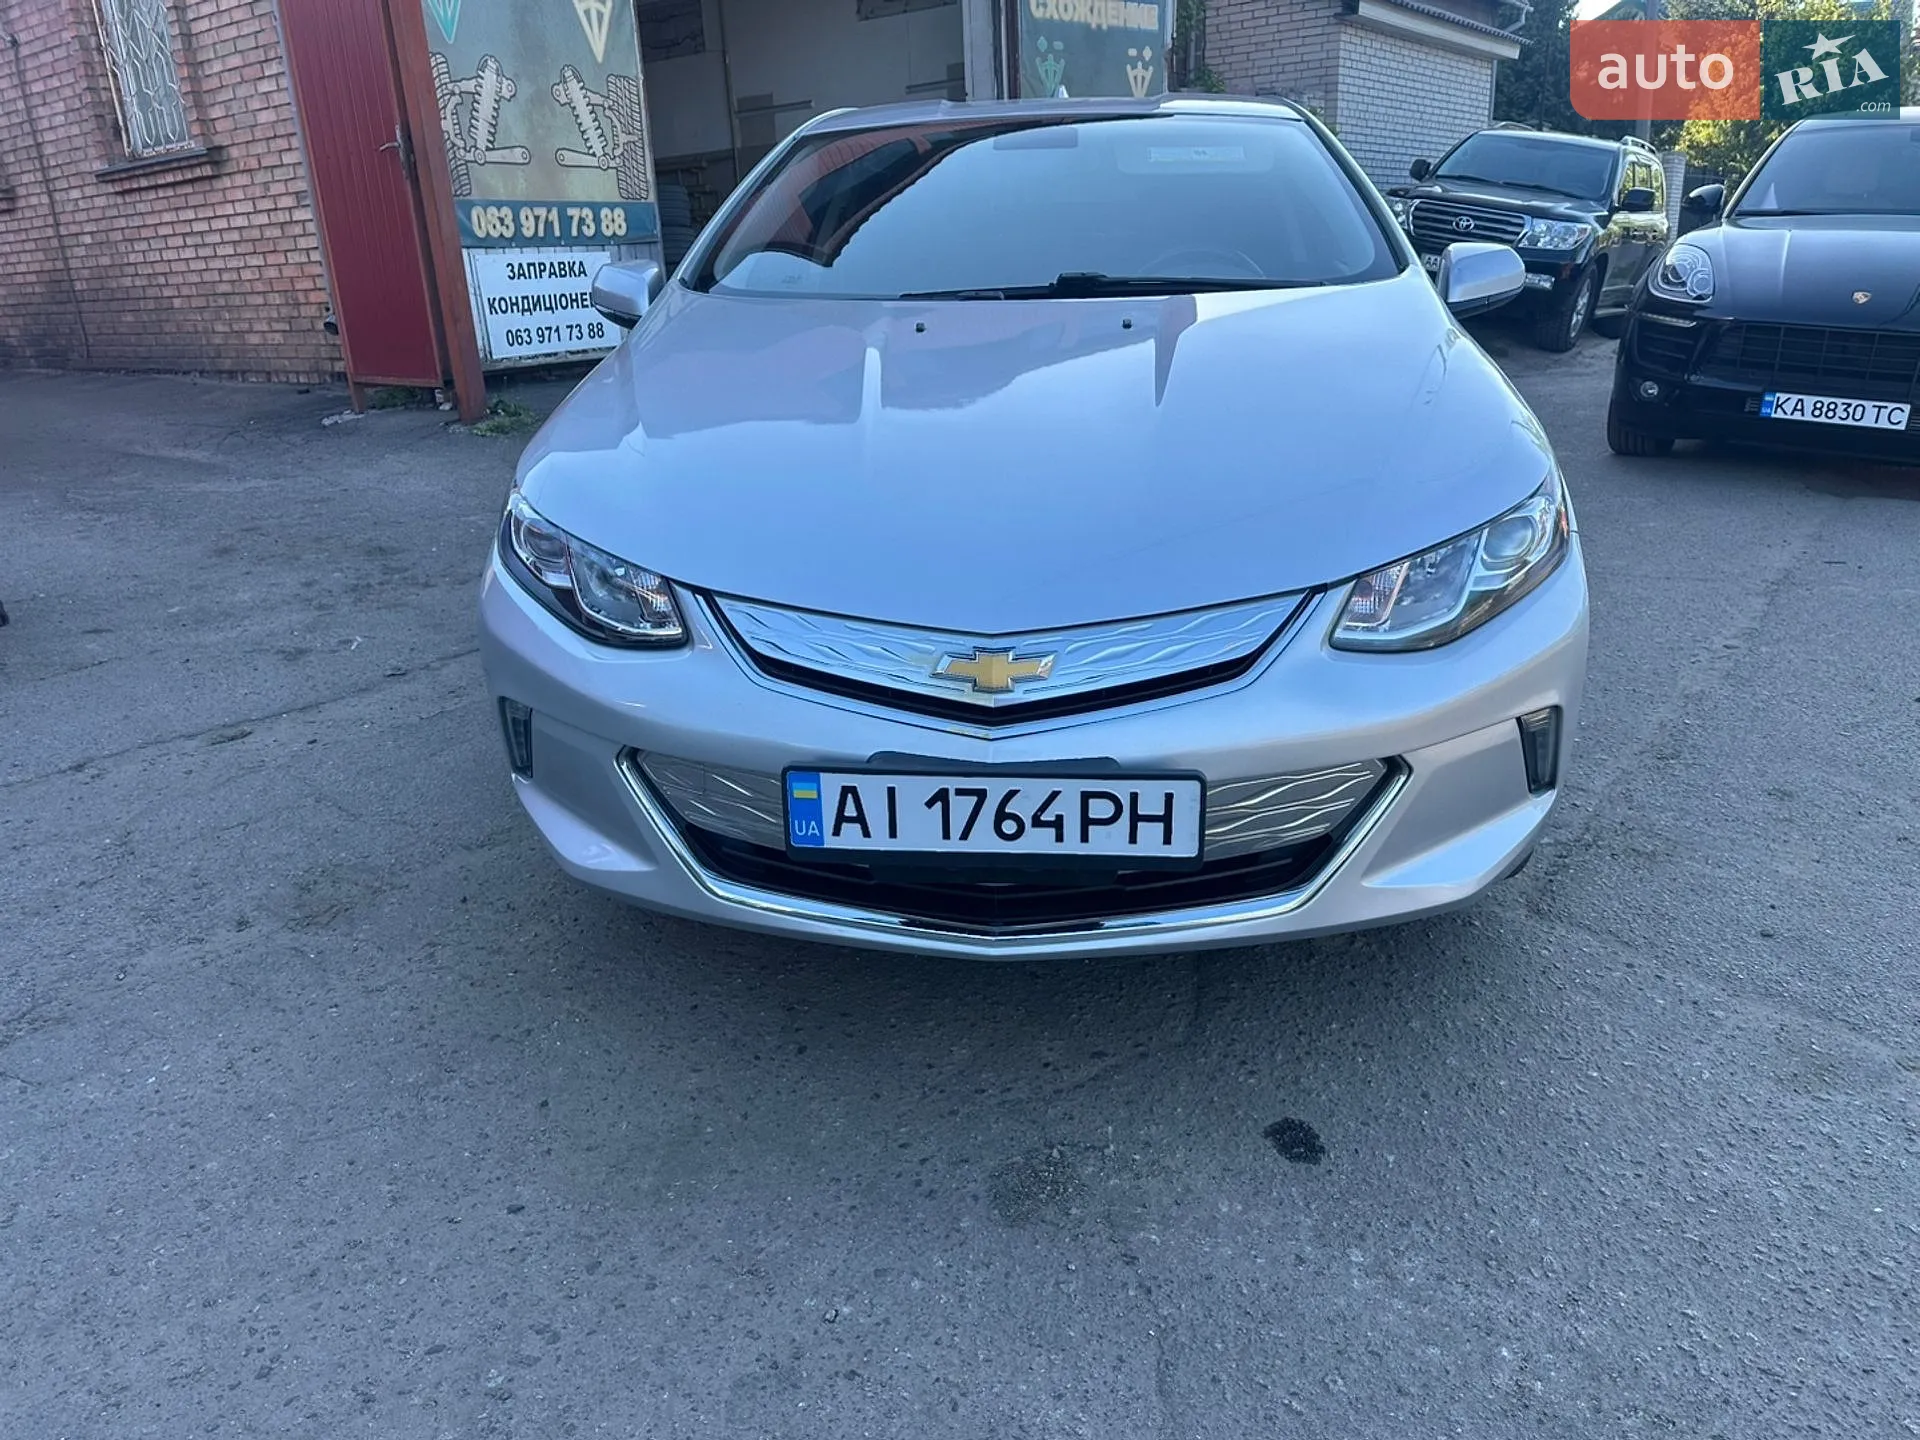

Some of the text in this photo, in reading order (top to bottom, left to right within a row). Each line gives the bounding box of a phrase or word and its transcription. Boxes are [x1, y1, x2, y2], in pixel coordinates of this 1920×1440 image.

[519, 206, 560, 238] 971
[566, 207, 596, 237] 73
[600, 206, 627, 237] 88
[505, 260, 588, 281] ЗАПРАВКА
[506, 322, 605, 347] 063 971 73 88
[1773, 396, 1906, 426] KA 8830 TC
[831, 785, 898, 839] AI
[794, 819, 821, 838] UA
